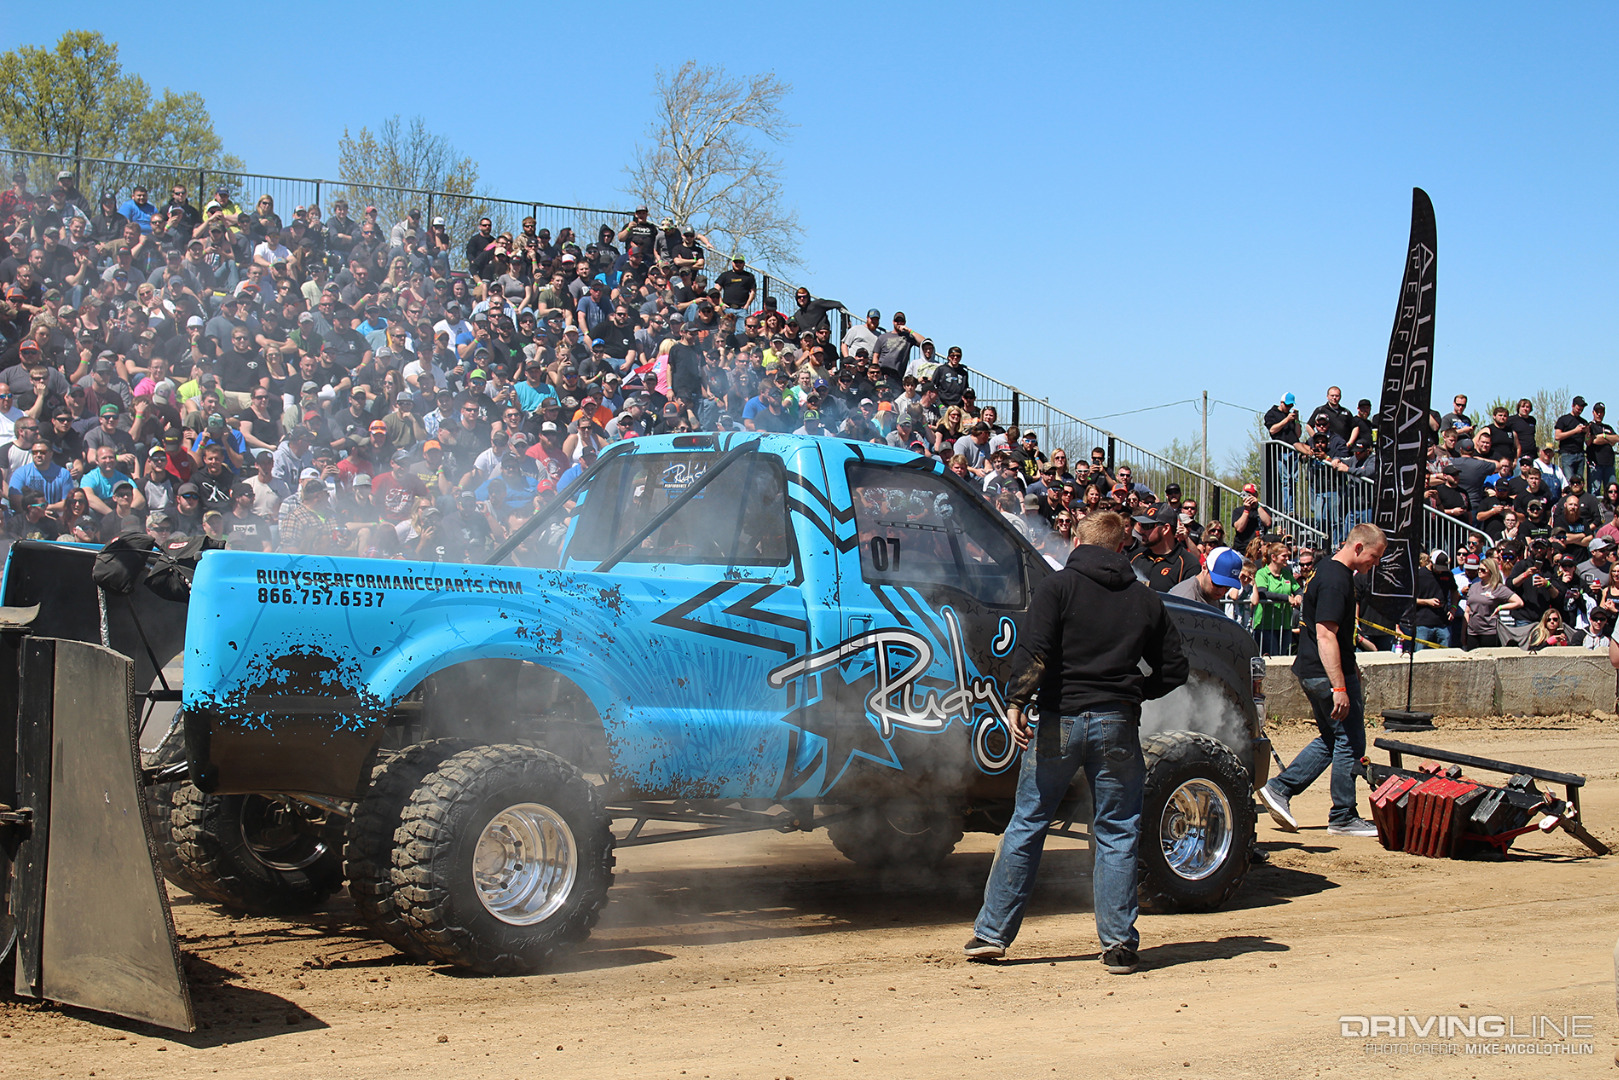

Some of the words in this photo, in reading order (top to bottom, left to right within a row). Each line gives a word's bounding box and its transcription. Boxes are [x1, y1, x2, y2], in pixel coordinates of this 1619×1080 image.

[1379, 256, 1420, 523] PERFORMANCE
[1398, 242, 1434, 533] ALLIGATOR
[256, 569, 524, 595] RUDYSPERFORMANCEPARTS.COM
[257, 588, 385, 608] 866.757.6537
[870, 536, 901, 572] 07
[768, 607, 1040, 772] Rudy'
